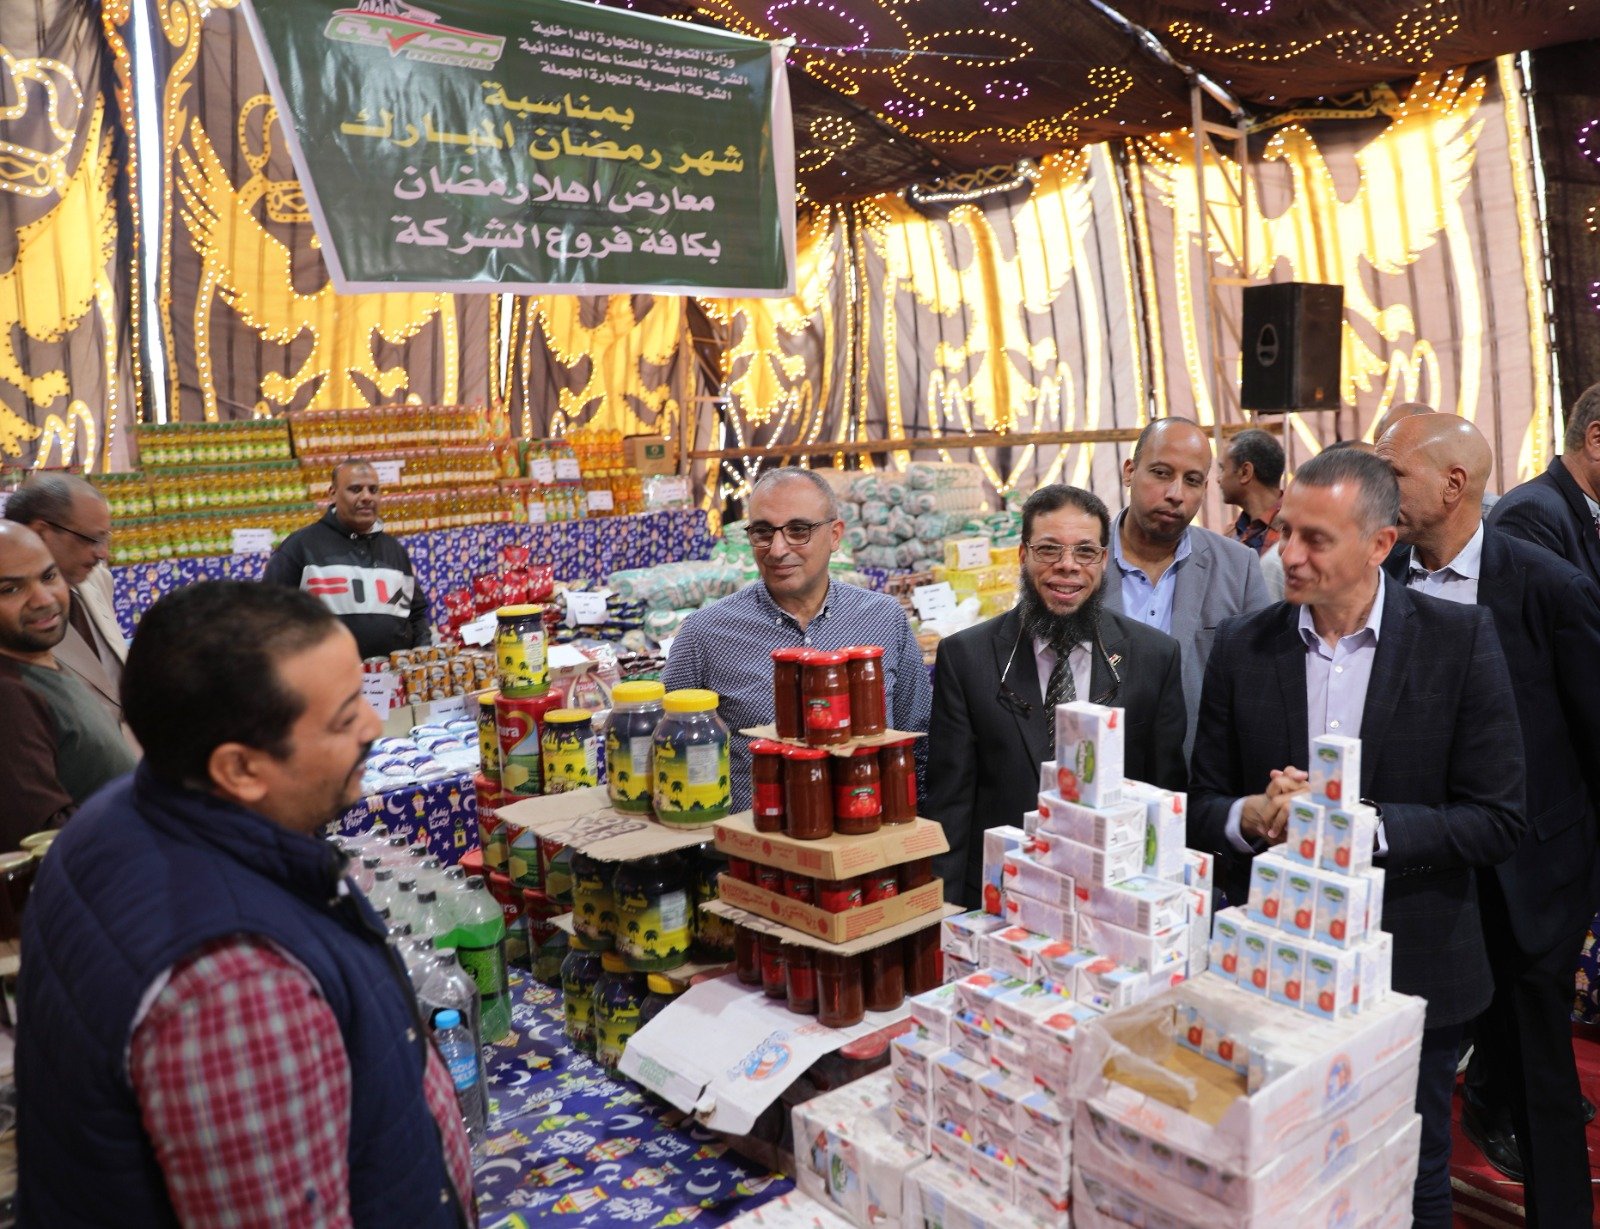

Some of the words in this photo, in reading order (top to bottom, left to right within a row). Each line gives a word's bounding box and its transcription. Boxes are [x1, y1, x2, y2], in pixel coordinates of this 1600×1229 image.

[530, 20, 596, 43] الداخلية
[596, 32, 652, 54] والتجارة
[517, 37, 580, 59] الغذائية
[581, 47, 649, 70] للصناعات
[655, 43, 706, 61] التموين
[705, 50, 736, 69] وزارة
[539, 60, 589, 80] الجملة
[589, 67, 633, 86] لتجارة
[650, 58, 704, 79] القابضة
[704, 68, 749, 86] الشركة
[634, 74, 686, 94] المصرية
[686, 82, 733, 101] الشركة
[481, 80, 635, 131] بمناسبة
[340, 107, 515, 155] المبارك
[529, 127, 662, 170] رمضان
[670, 144, 744, 176] شهر
[394, 165, 529, 205] رمضان
[532, 173, 600, 204] اهلا
[608, 180, 715, 215] معارض
[390, 215, 540, 254] الشركة
[546, 225, 633, 259] فروع
[636, 227, 721, 264] بكافة
